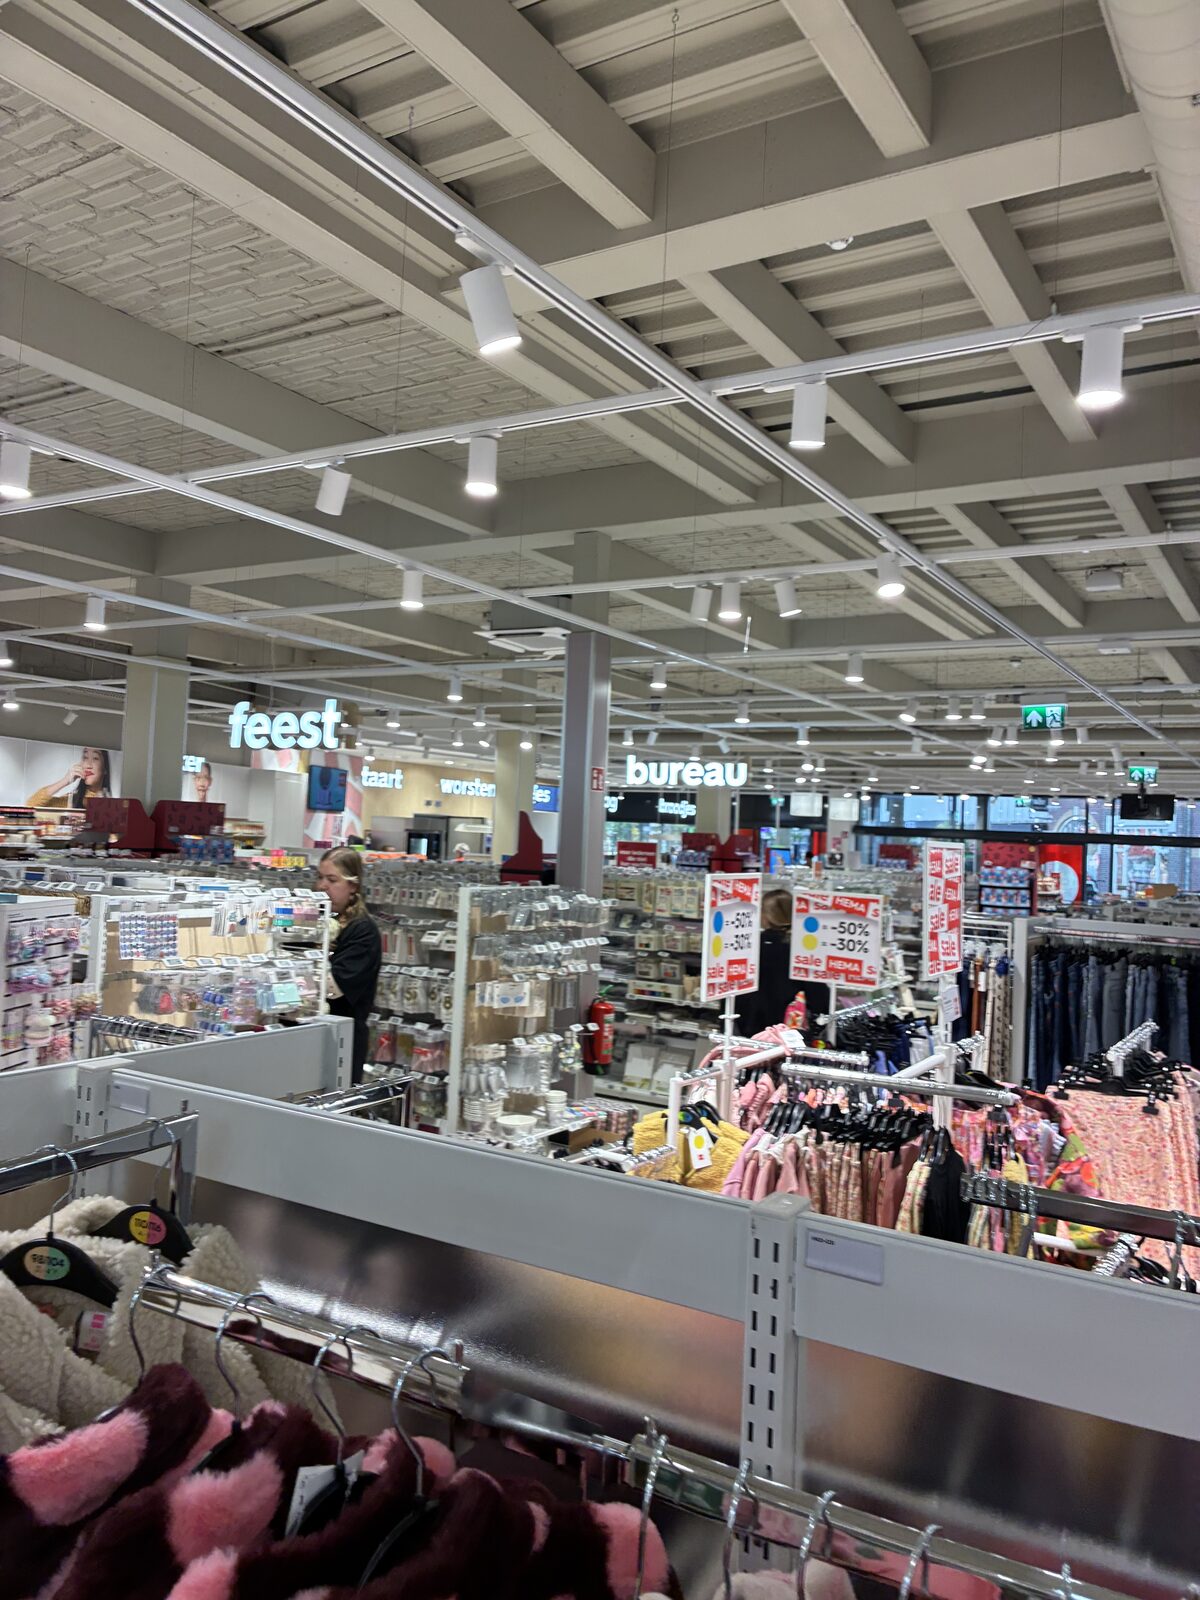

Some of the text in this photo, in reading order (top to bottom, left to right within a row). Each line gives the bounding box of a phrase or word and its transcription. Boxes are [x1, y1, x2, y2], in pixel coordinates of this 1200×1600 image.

[229, 698, 341, 749] feest
[361, 765, 404, 789] taart
[626, 755, 748, 787] bureau
[440, 777, 496, 798] worsten
[835, 896, 866, 912] HEMA
[830, 921, 870, 937] -50%
[830, 938, 869, 954] -30%
[795, 955, 822, 967] sale
[829, 960, 860, 972] HEMA
